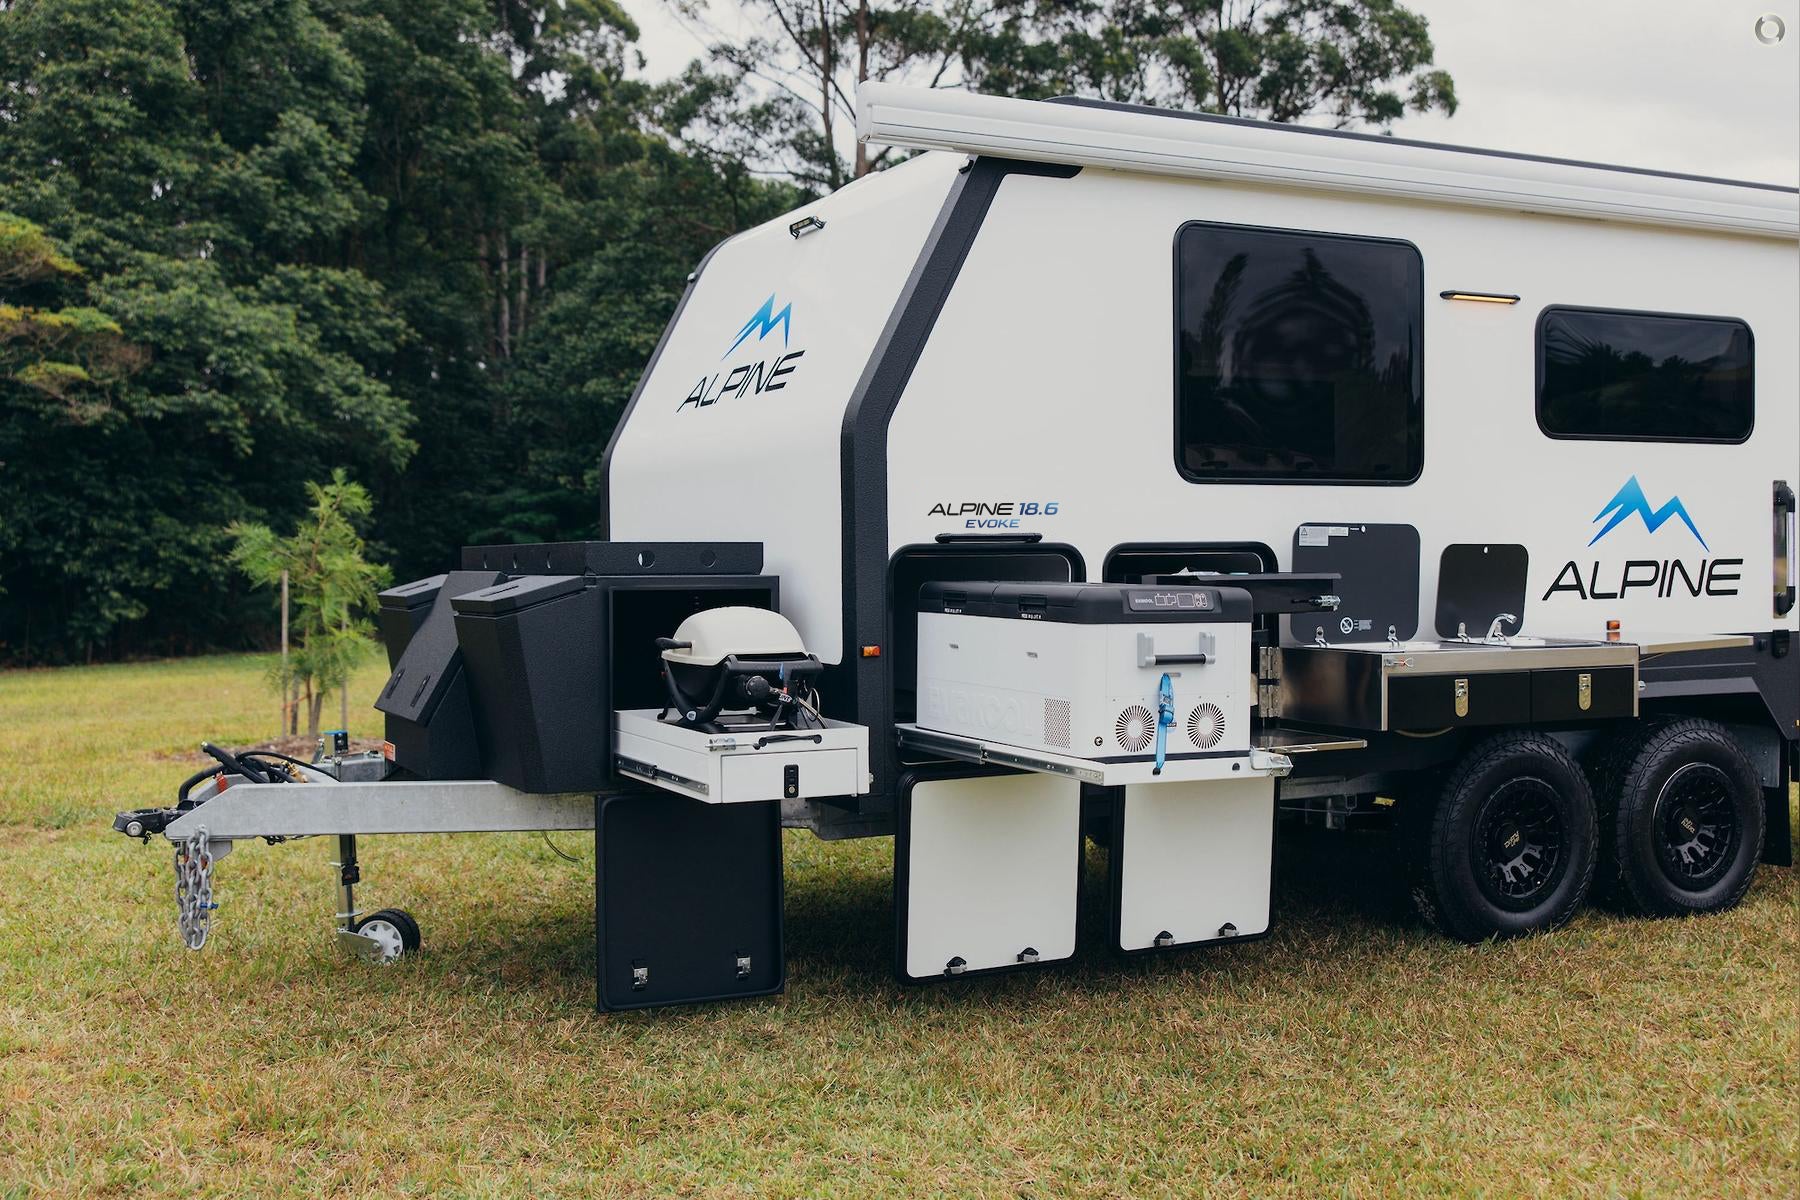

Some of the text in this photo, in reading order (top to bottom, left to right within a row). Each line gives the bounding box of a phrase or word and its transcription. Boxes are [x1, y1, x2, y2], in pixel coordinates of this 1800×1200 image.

[676, 350, 805, 413] ALPINE
[928, 502, 1059, 515] ALPINE 18.6
[965, 519, 1020, 528] EVOKE
[1541, 558, 1744, 601] ALPINE
